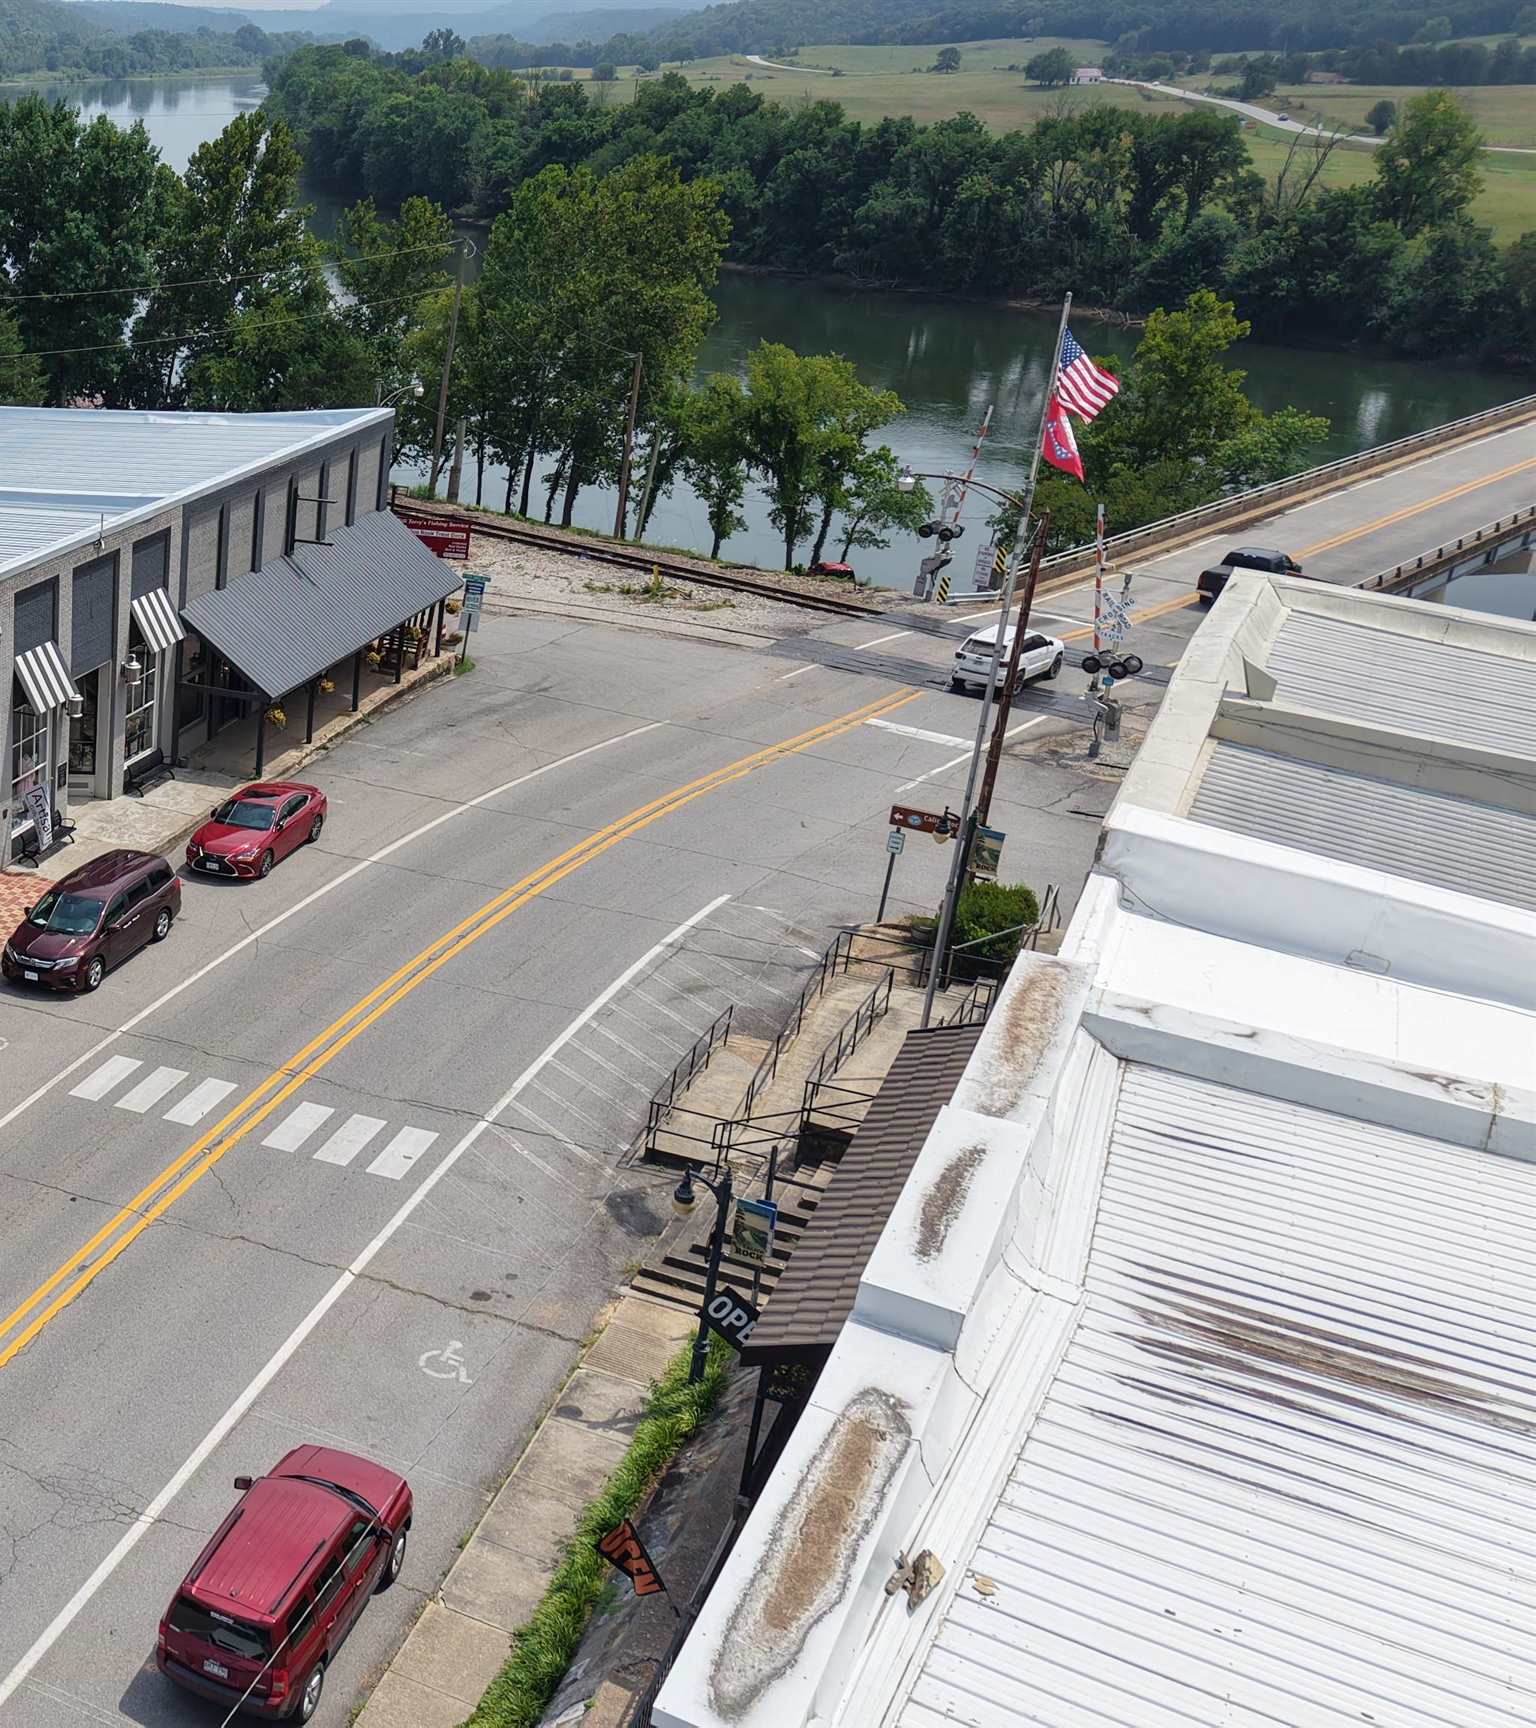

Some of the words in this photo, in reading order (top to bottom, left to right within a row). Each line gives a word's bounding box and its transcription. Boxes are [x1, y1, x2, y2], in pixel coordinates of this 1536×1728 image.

[1098, 598, 1135, 624] CROSSING
[735, 1247, 764, 1262] ROCK
[707, 1295, 758, 1347] OPE
